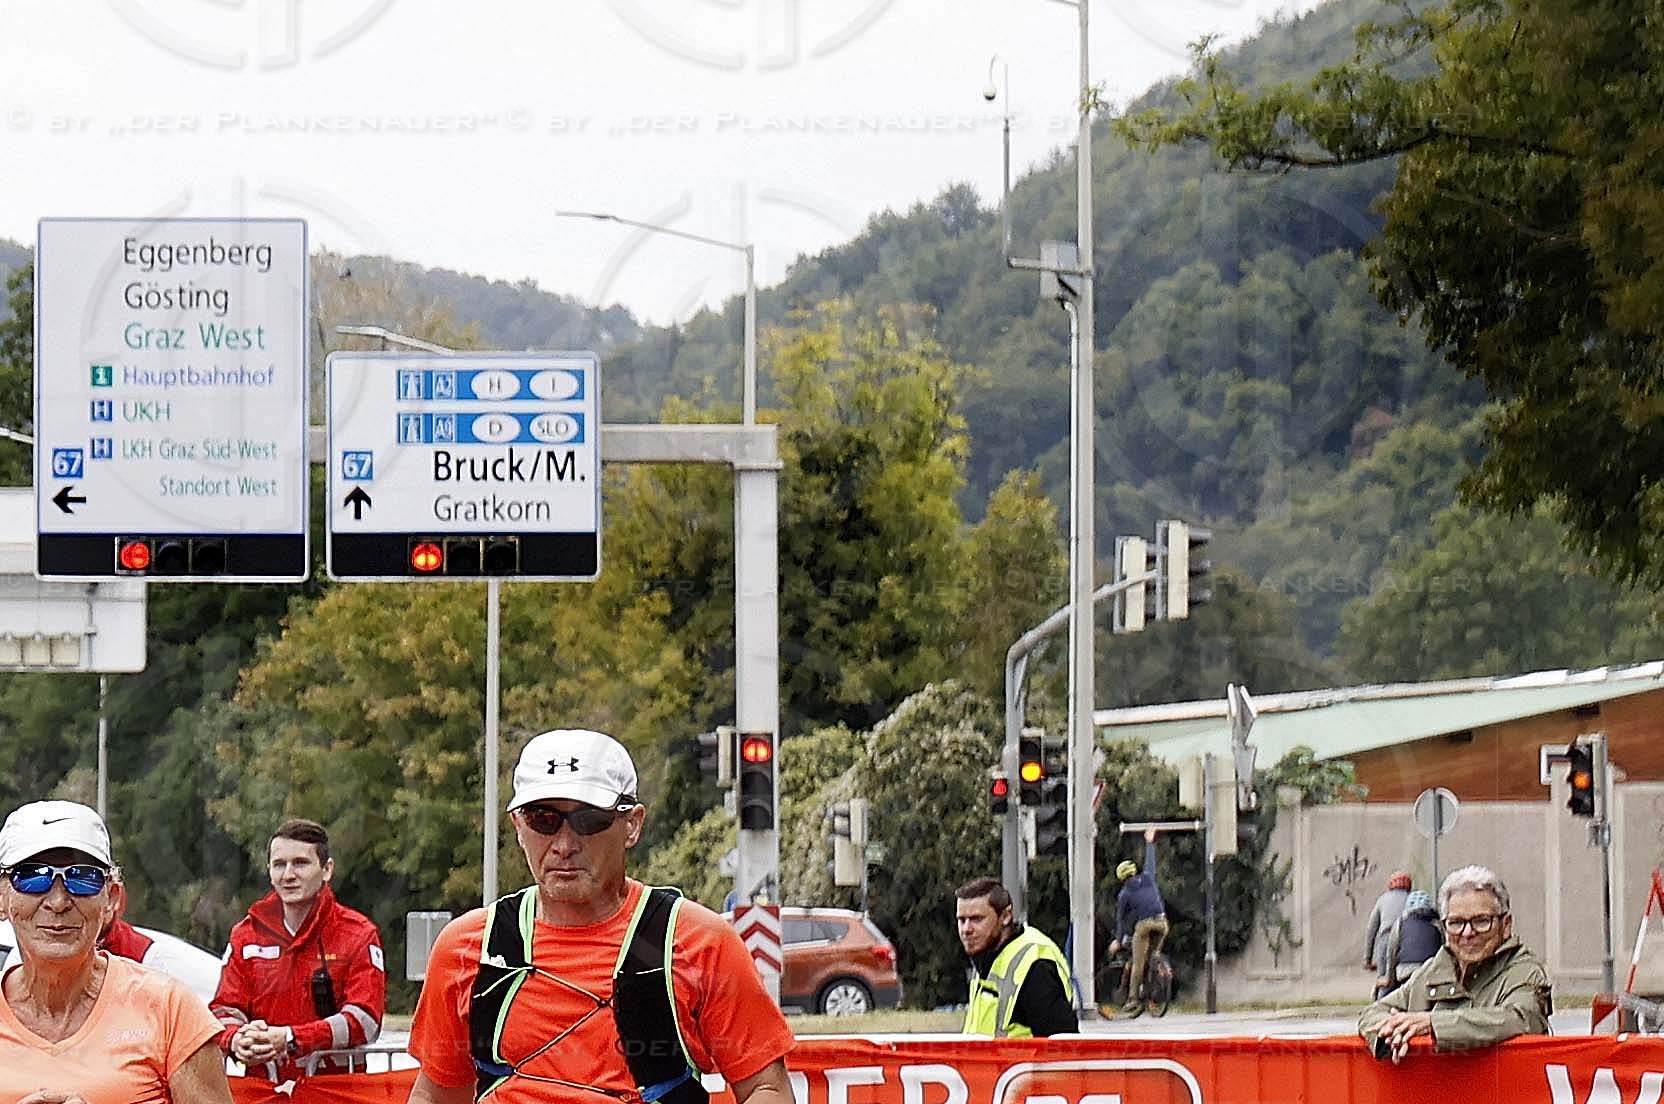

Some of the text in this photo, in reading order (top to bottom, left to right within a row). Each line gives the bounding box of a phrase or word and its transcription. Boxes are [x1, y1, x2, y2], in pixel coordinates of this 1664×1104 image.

[123, 237, 272, 272] Eggenberg
[124, 281, 229, 317] Gösting
[124, 322, 266, 350] Graz West
[123, 365, 275, 389] Hauptbahnhof
[488, 377, 502, 393] H
[122, 401, 171, 422] UKH
[488, 420, 503, 436] D
[536, 420, 569, 436] SLO
[122, 438, 152, 460] LKH
[159, 438, 195, 460] Graz
[202, 436, 278, 460] Süd-West
[53, 450, 82, 476] 67
[343, 452, 372, 478] 67
[434, 447, 586, 481] Bruck/M.
[159, 475, 277, 497] Standort West
[434, 494, 551, 522] Gratkorn
